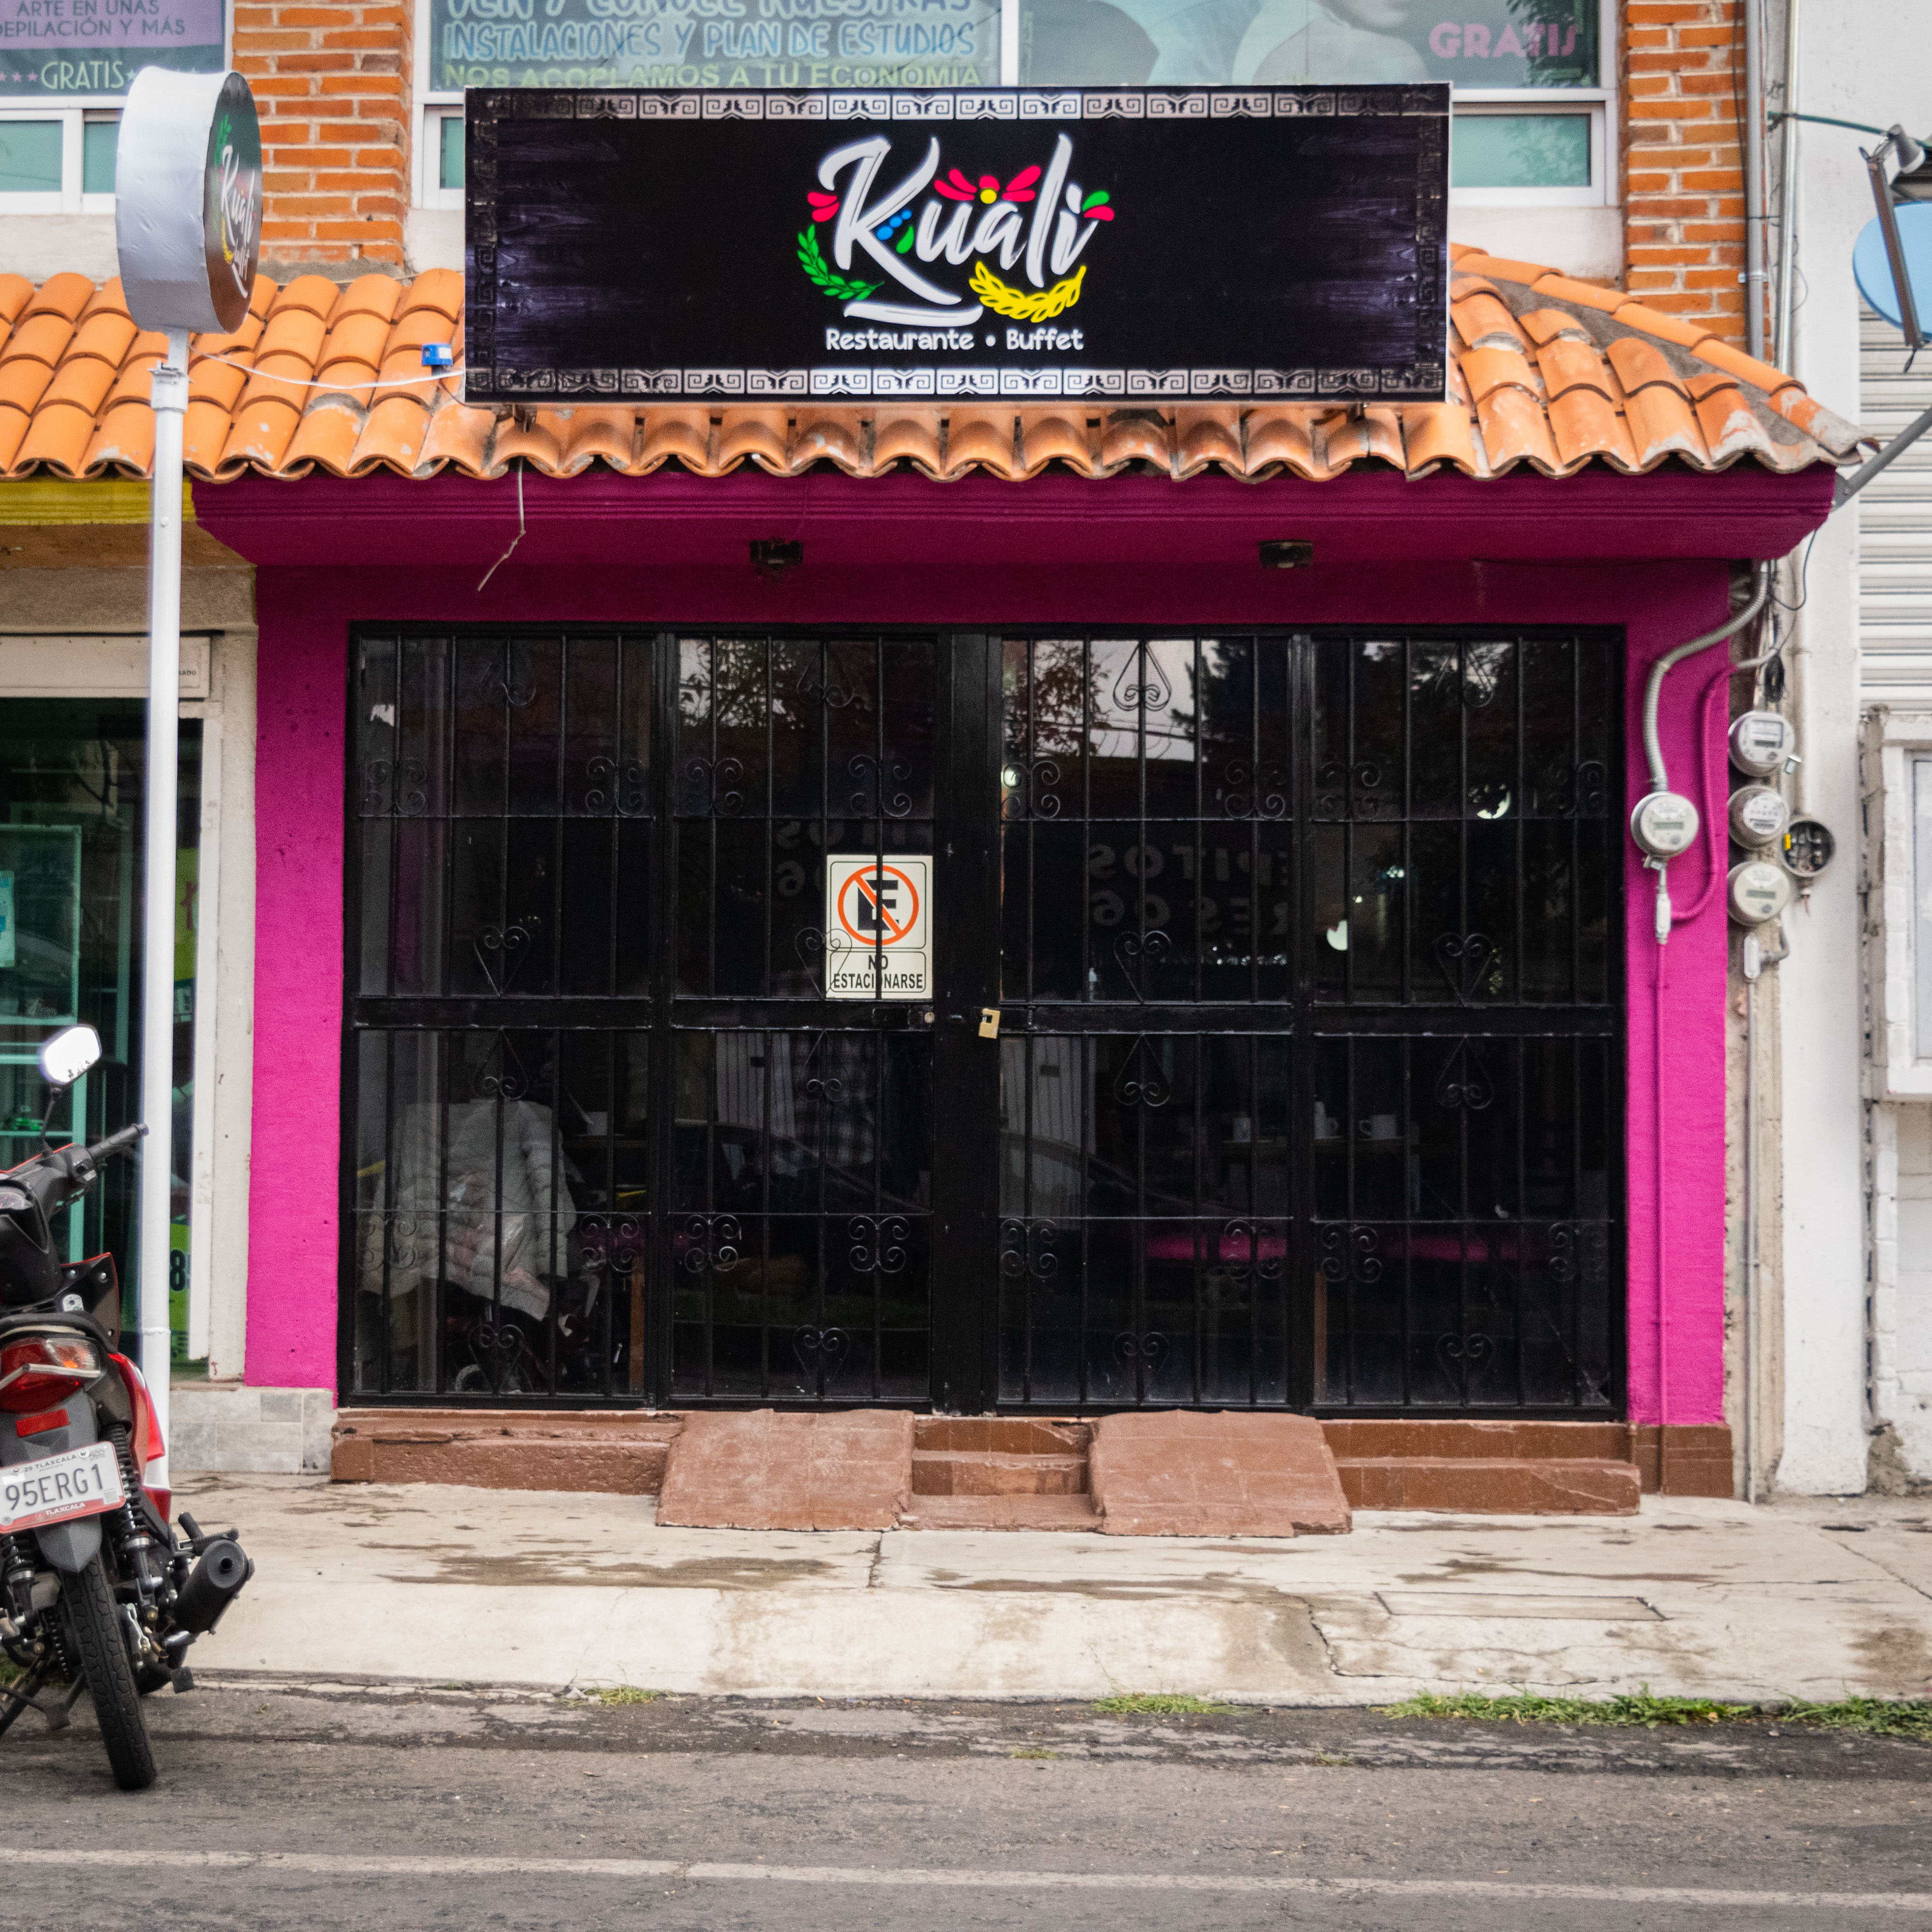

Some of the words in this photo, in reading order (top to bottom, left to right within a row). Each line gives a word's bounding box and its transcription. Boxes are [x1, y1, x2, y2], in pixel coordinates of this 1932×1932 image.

[16, 0, 63, 16] ARTE
[73, 0, 97, 16] EN
[0, 17, 111, 37] EPILACIÓN
[119, 19, 132, 35] Y
[142, 15, 185, 35] MÁS
[444, 20, 662, 60] INSTALACIONES
[675, 21, 696, 57] Y
[705, 22, 781, 57] PLAN
[791, 22, 827, 57] DE
[839, 21, 975, 57] ESTUDIOS
[41, 60, 125, 90] GRATIS
[445, 64, 511, 87] NOS
[728, 64, 750, 87] A
[765, 63, 799, 87] TU
[818, 133, 1099, 306] Kuali
[825, 328, 975, 351] Restaurante
[1006, 327, 1084, 351] Buffet
[868, 954, 889, 970] NO
[834, 973, 923, 989] ESTACINARSE
[35, 1454, 77, 1469] TLAXCALA
[5, 1463, 103, 1511] 95ERG1
[45, 1502, 86, 1516] TLAXCALA
